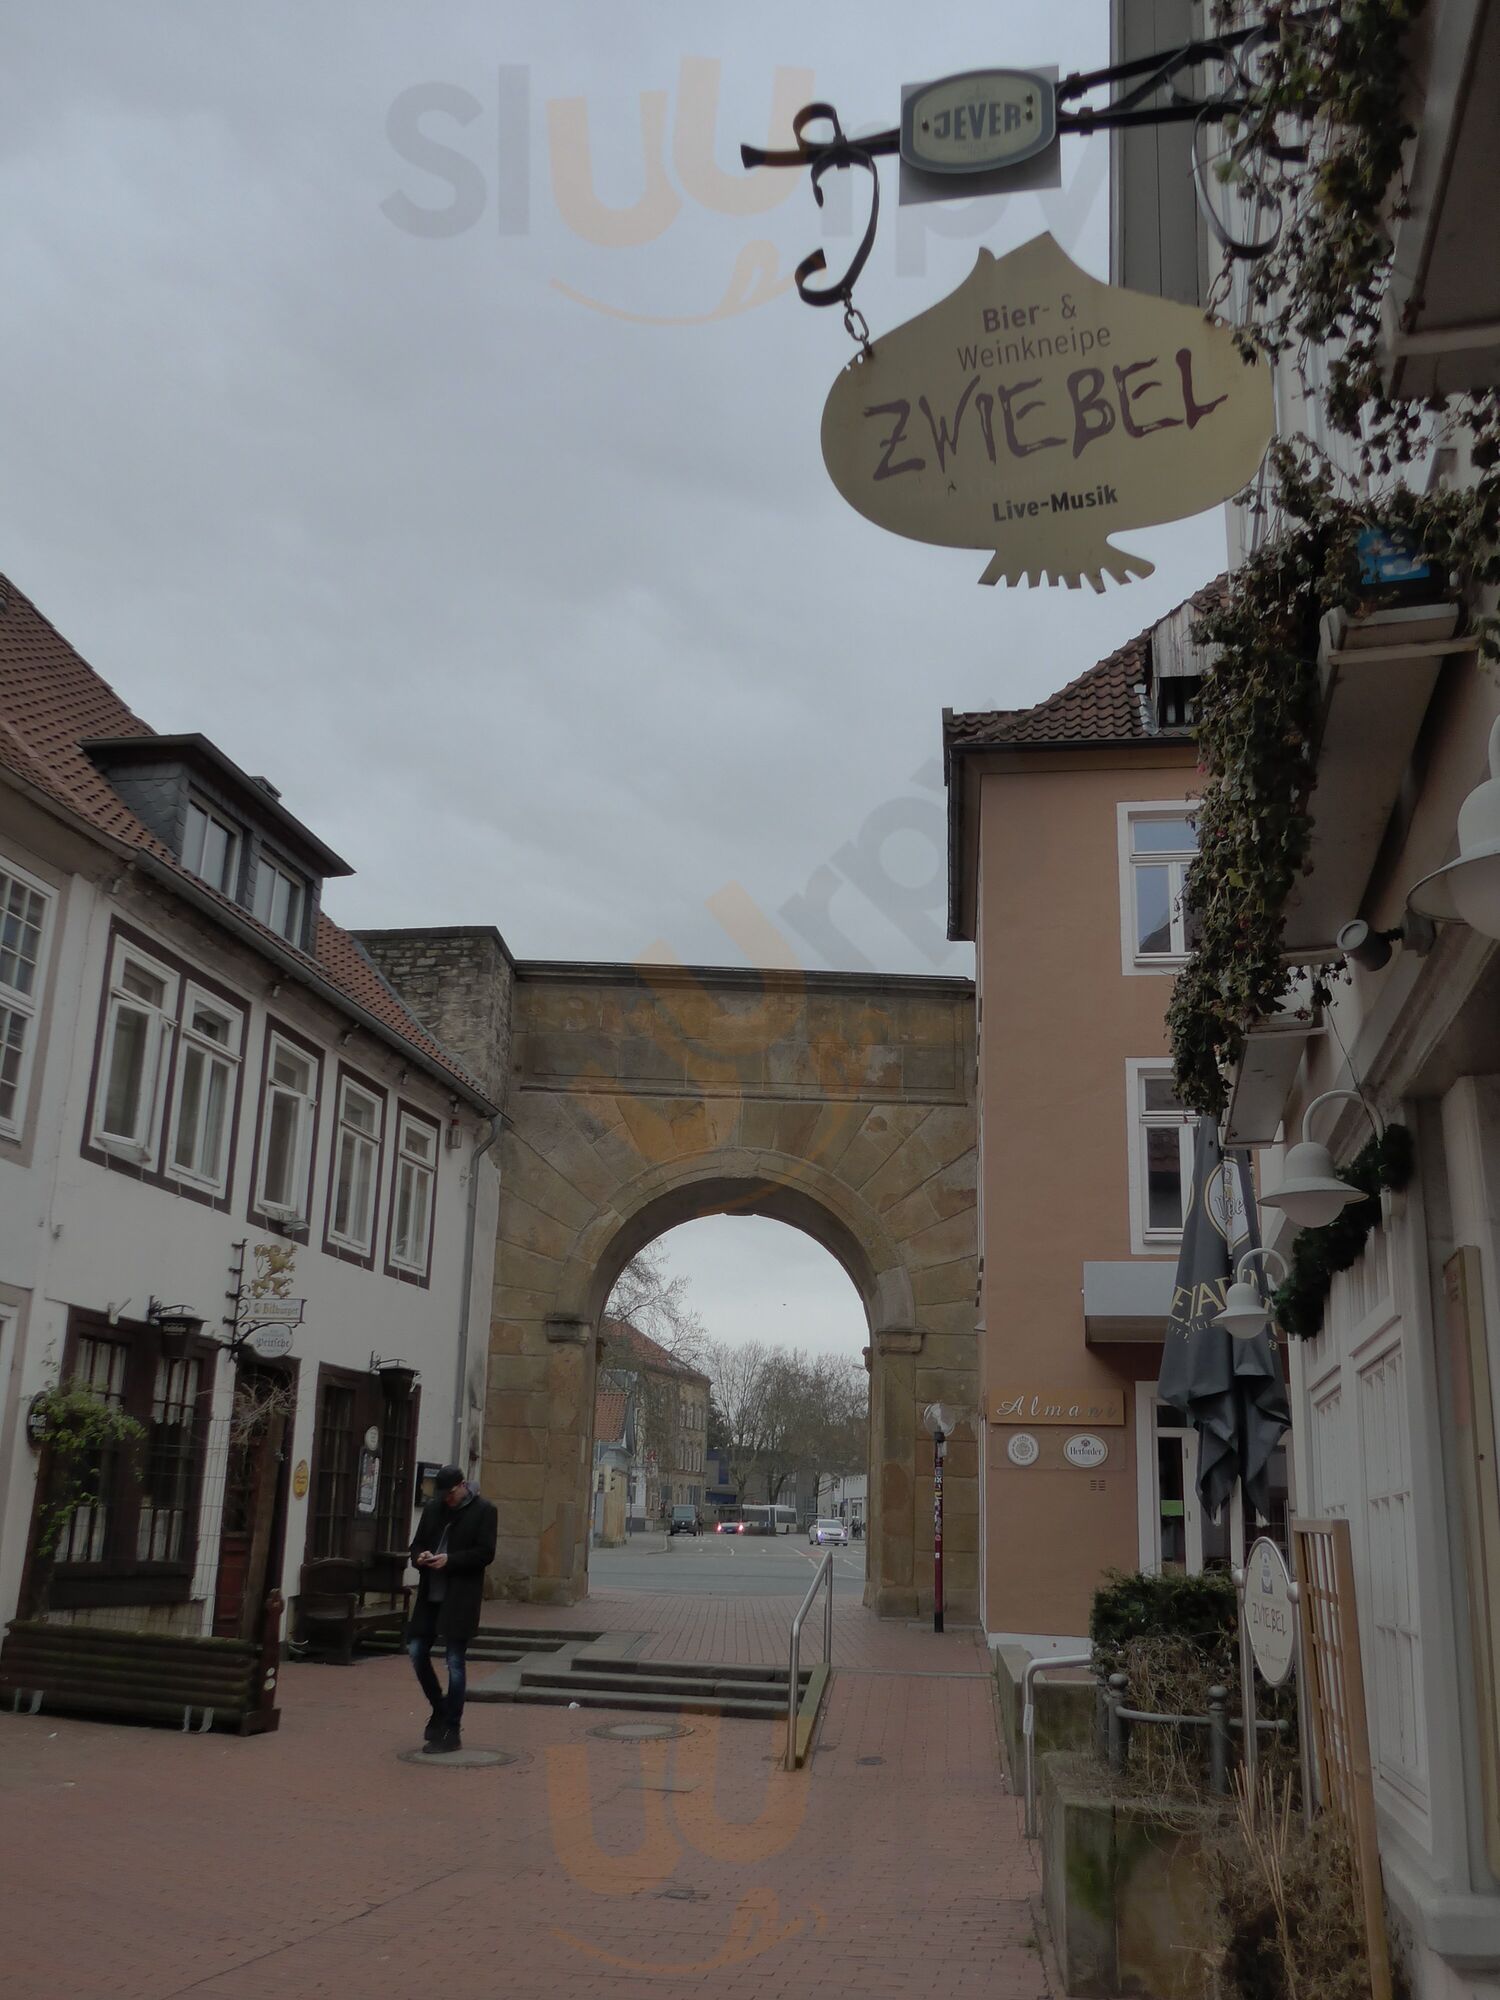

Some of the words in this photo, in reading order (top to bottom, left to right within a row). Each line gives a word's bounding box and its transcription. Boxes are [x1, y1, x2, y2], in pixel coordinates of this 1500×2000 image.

[933, 101, 1021, 141] JEVER
[982, 304, 1050, 333] Bier-
[1061, 293, 1077, 319] &
[957, 327, 1111, 371] Weinkneipe
[863, 349, 1228, 481] ZWIEBEL
[993, 484, 1118, 522] Live-Musik
